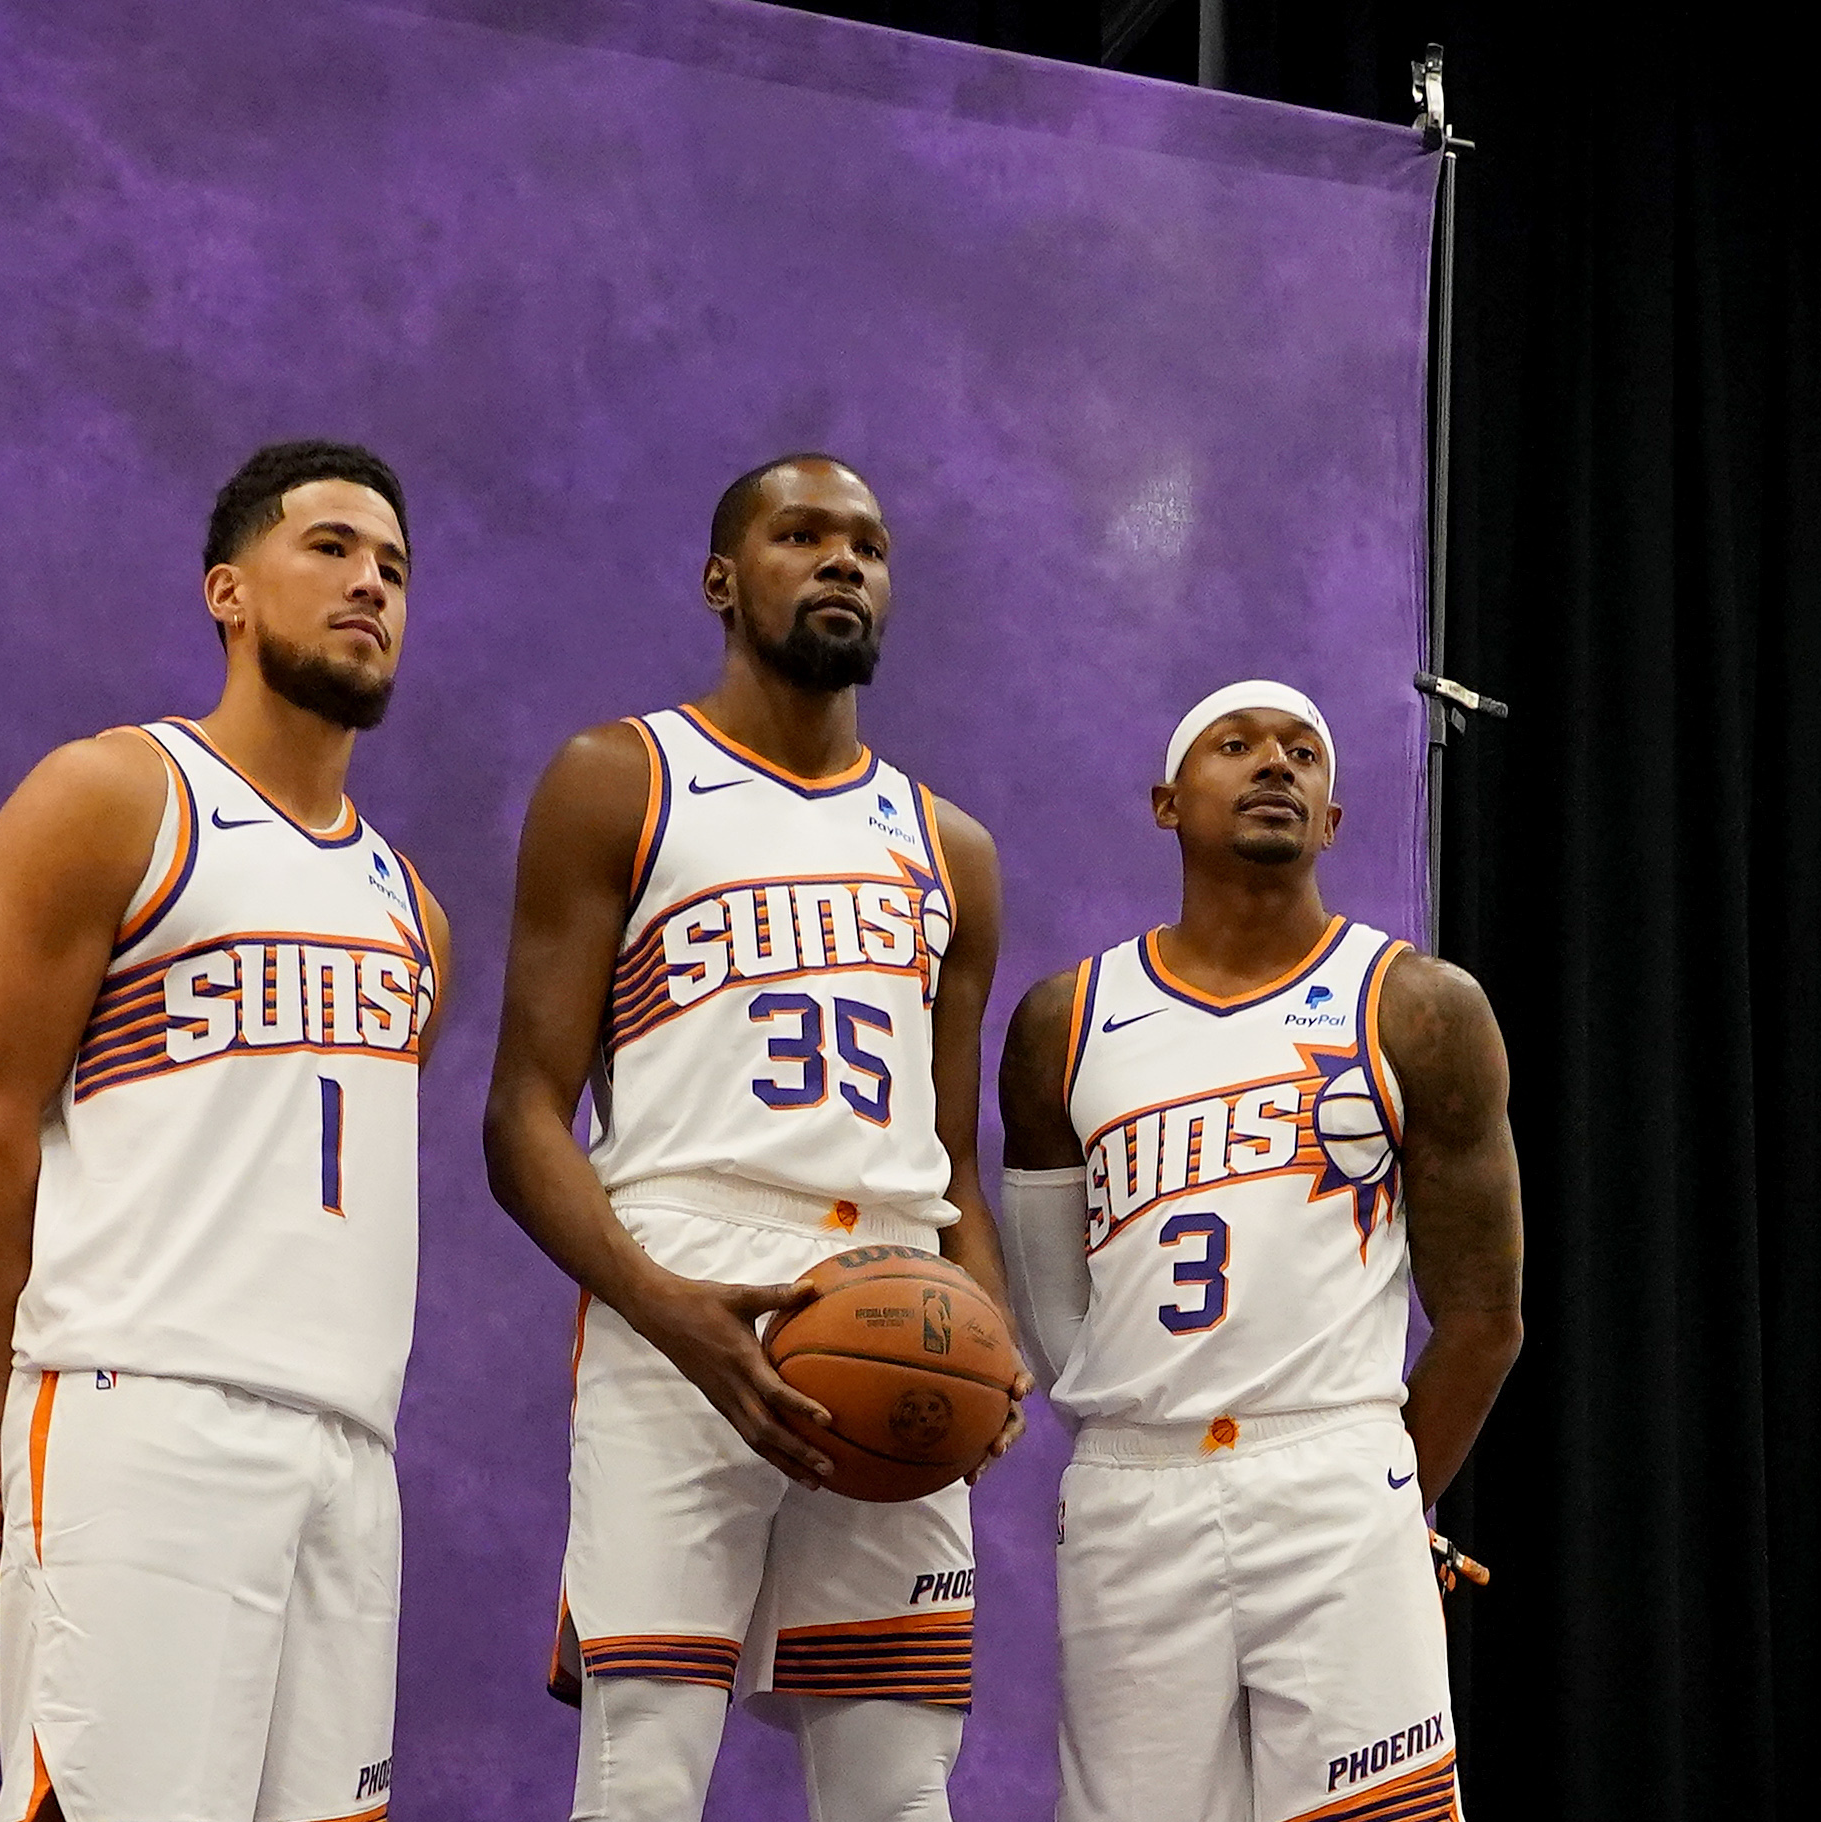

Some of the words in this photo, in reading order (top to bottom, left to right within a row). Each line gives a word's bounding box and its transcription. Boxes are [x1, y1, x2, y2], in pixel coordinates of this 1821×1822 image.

[868, 816, 916, 845] PayPal
[163, 943, 414, 1064] SUNS
[663, 882, 917, 1008] SUNS
[748, 992, 894, 1130] 35
[1284, 1014, 1347, 1028] PayPal
[318, 1075, 346, 1219] 1
[1086, 1082, 1302, 1248] SUNS
[1158, 1211, 1232, 1337] 3
[1326, 1711, 1446, 1793] PHOENIX
